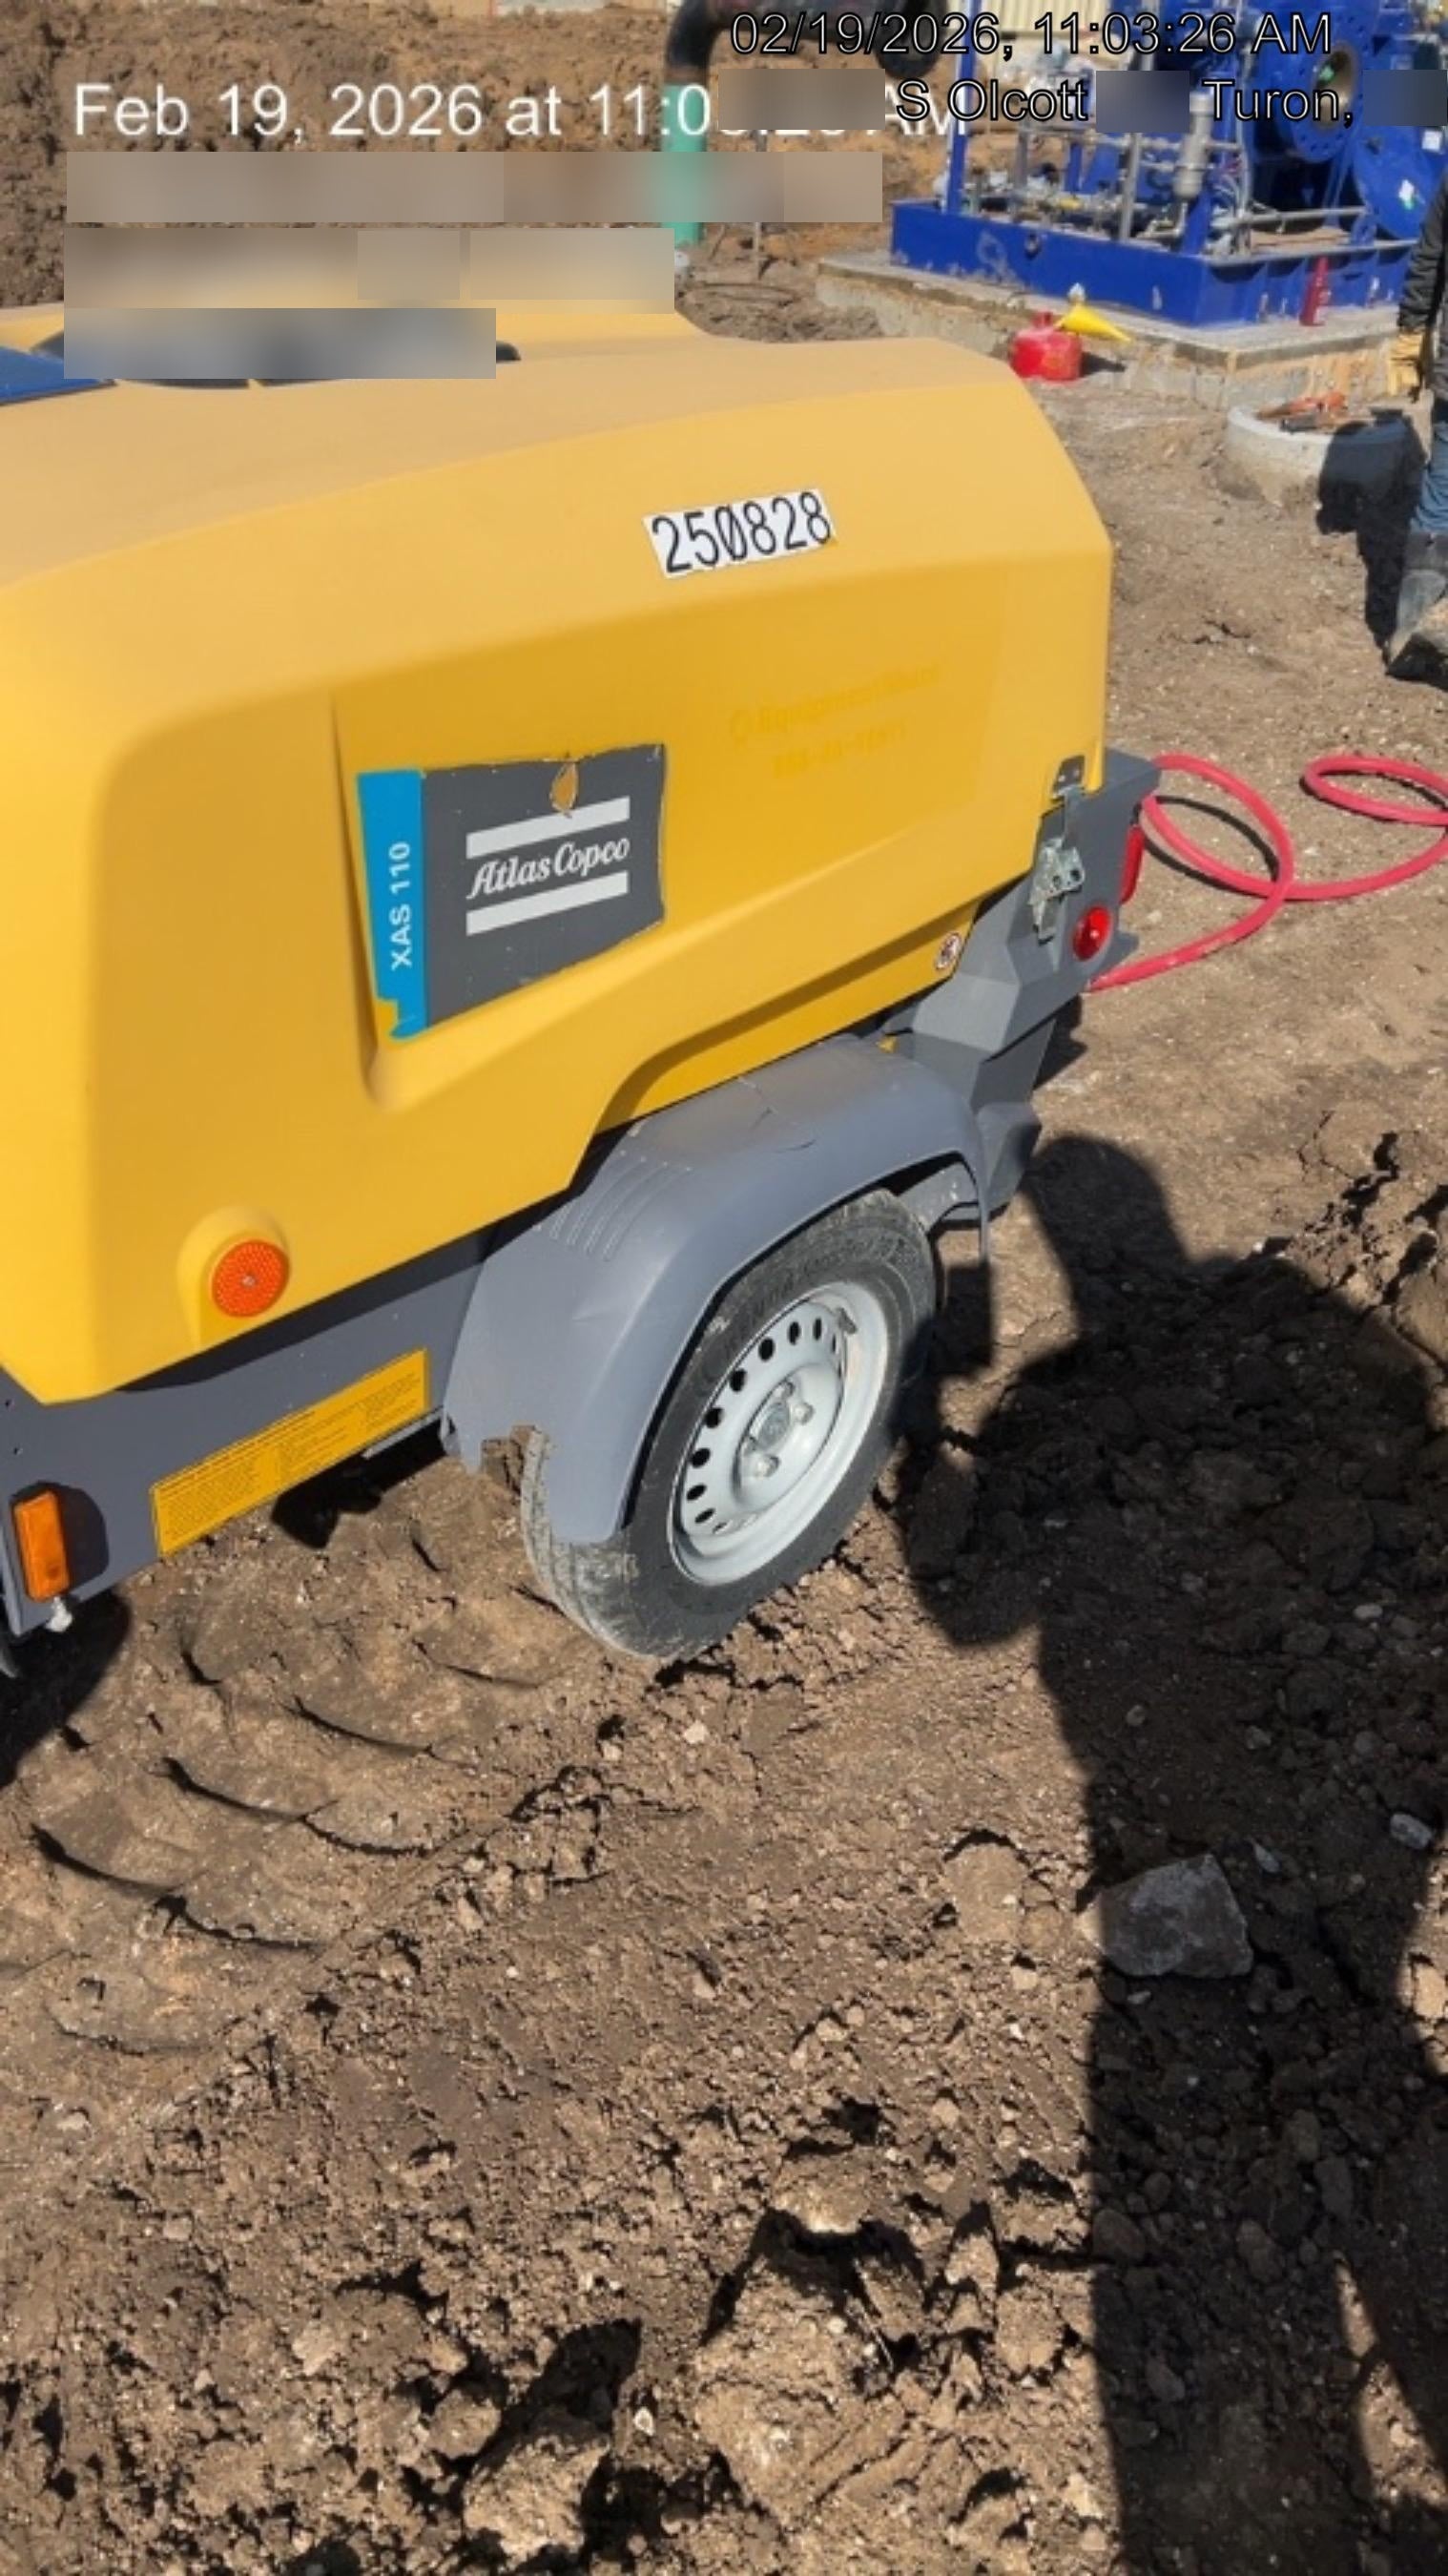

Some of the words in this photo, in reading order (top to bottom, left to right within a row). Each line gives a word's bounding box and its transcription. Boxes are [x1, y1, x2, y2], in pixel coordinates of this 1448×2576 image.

[652, 491, 831, 572] 250828
[387, 841, 412, 894] 110
[465, 849, 551, 901] Atlas
[553, 837, 631, 879] Copco
[389, 904, 413, 971] XAS
